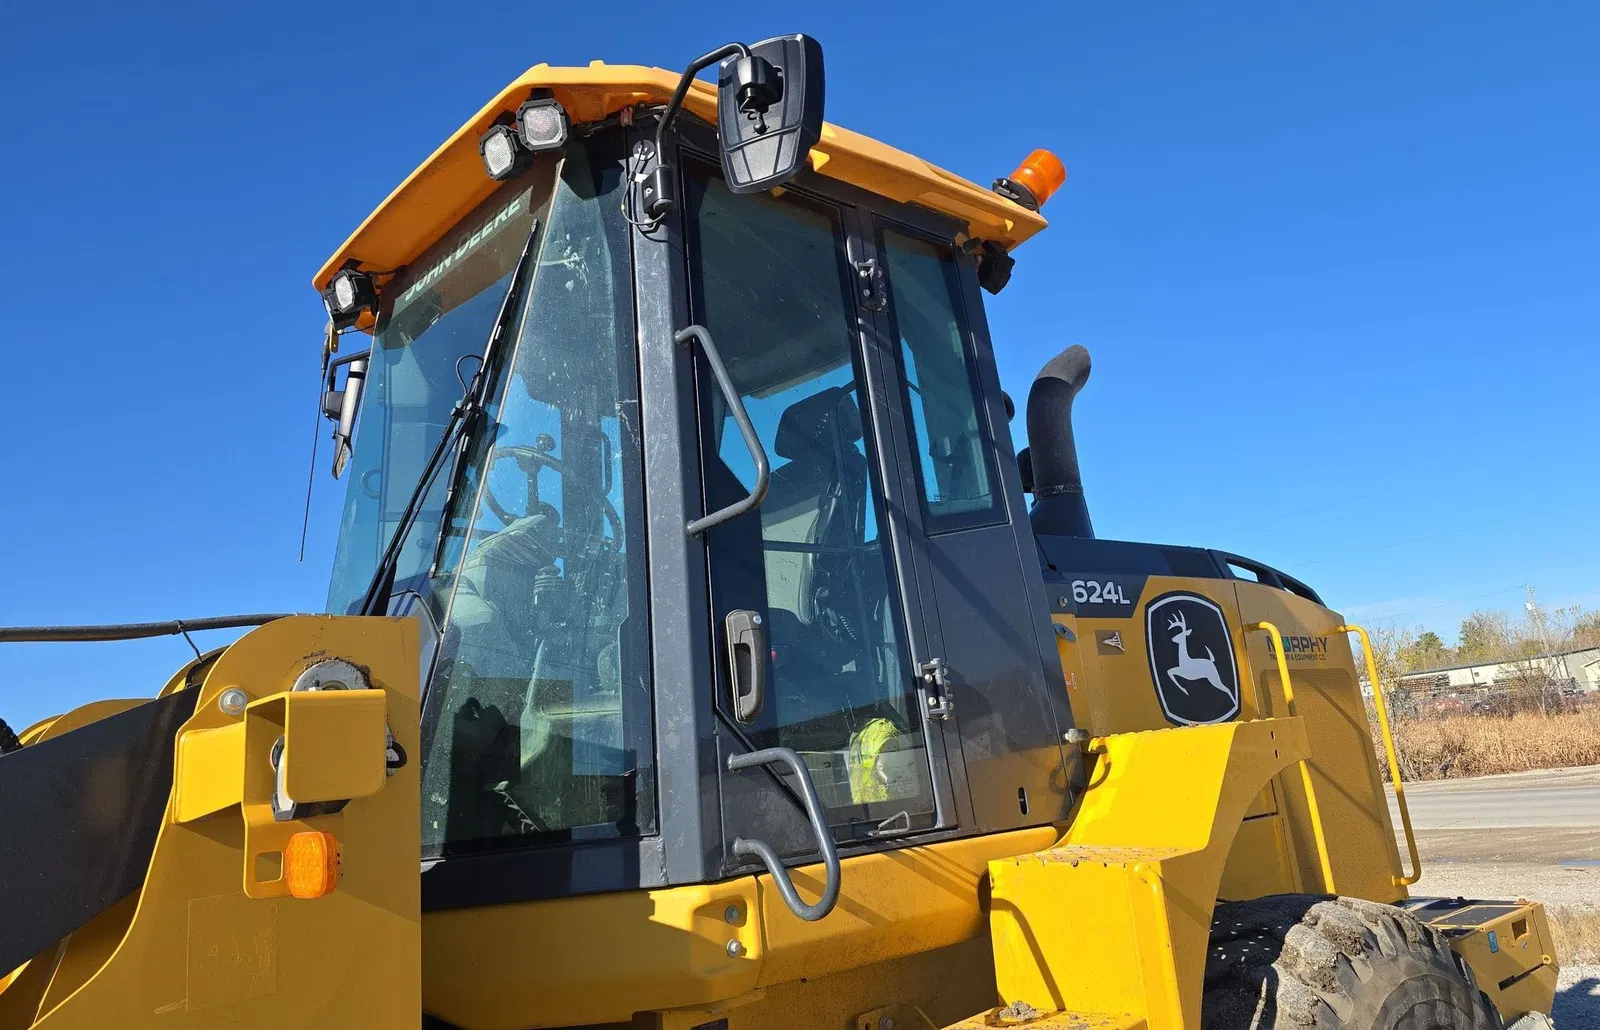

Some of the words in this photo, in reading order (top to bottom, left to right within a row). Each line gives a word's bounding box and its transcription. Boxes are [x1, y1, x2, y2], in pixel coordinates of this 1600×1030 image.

[405, 249, 453, 301] JOHN
[454, 190, 523, 260] DEERE
[1071, 580, 1131, 604] 624L
[1295, 653, 1318, 661] EQUIPMENT
